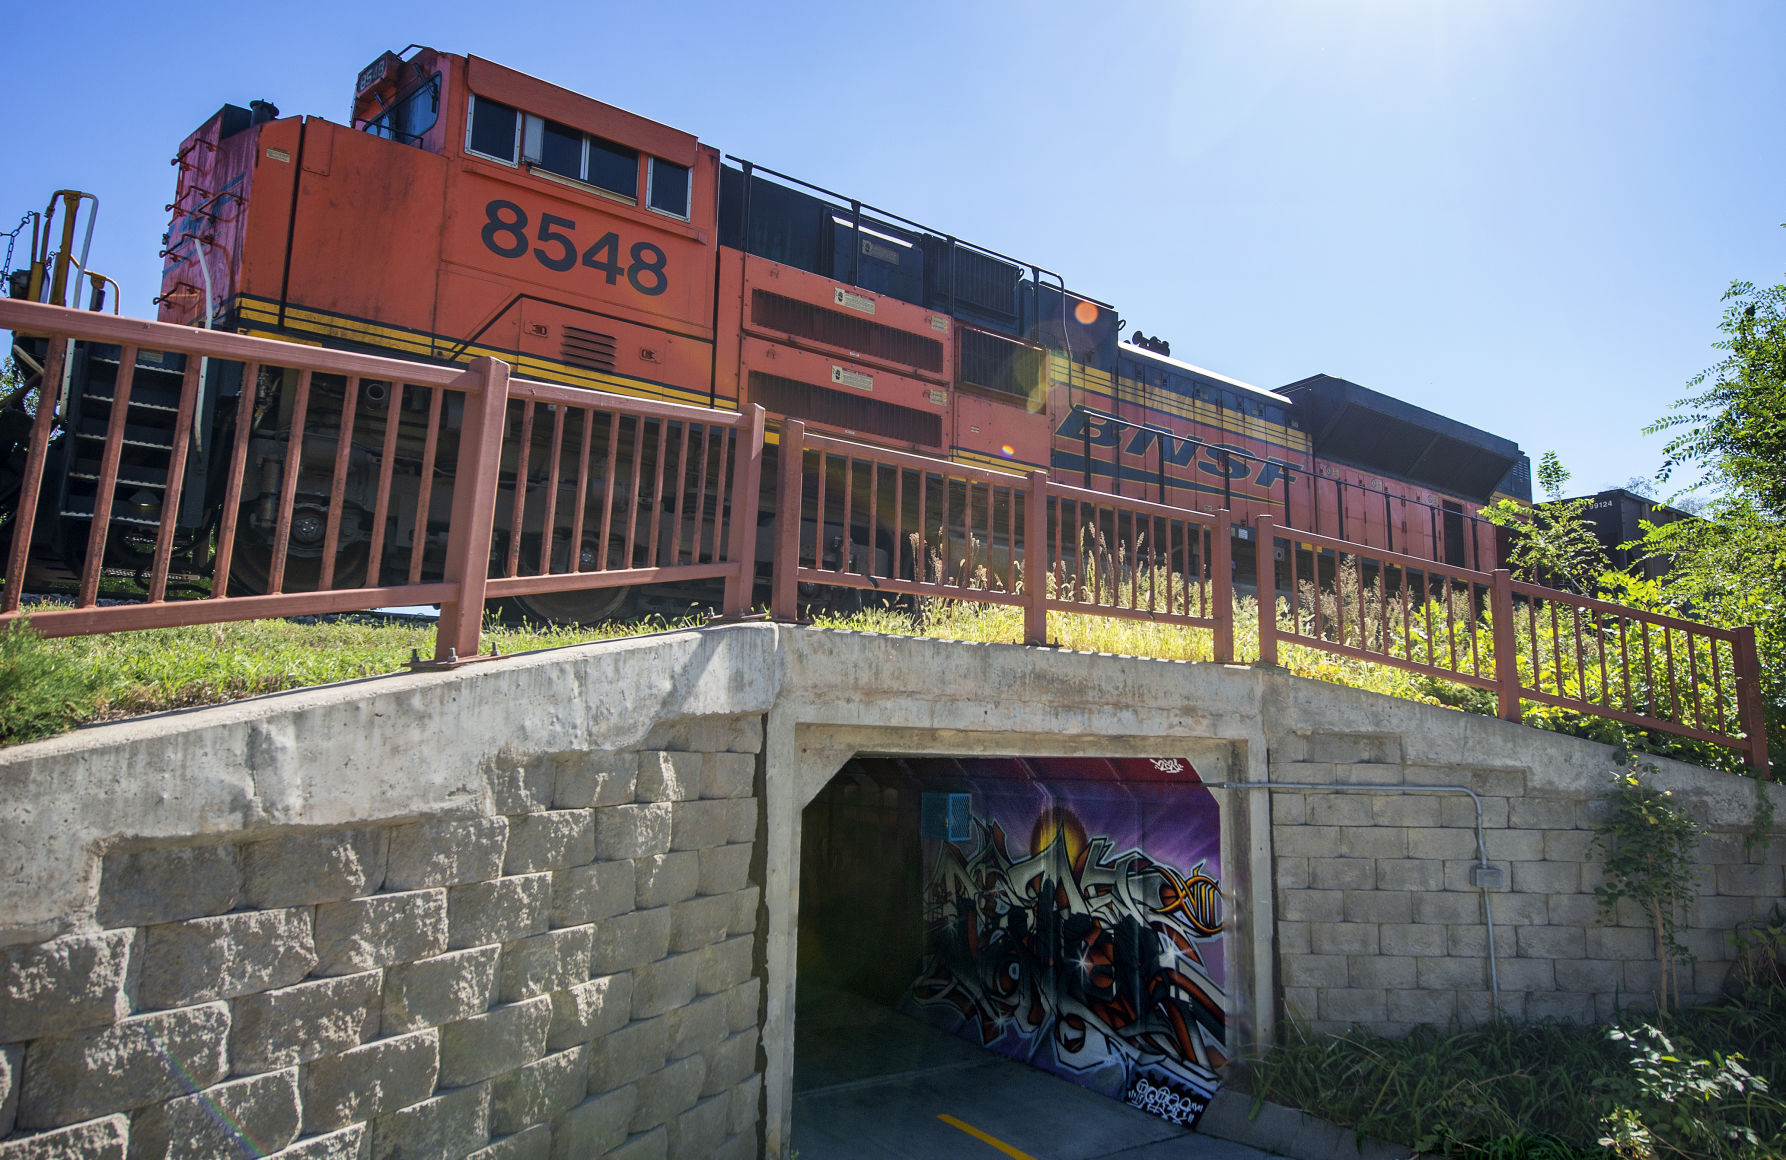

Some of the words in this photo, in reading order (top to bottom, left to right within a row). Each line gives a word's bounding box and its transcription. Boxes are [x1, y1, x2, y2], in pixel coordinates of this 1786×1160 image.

[481, 199, 668, 296] 8548
[1054, 403, 1304, 489] BNSF
[1589, 500, 1613, 510] 99124
